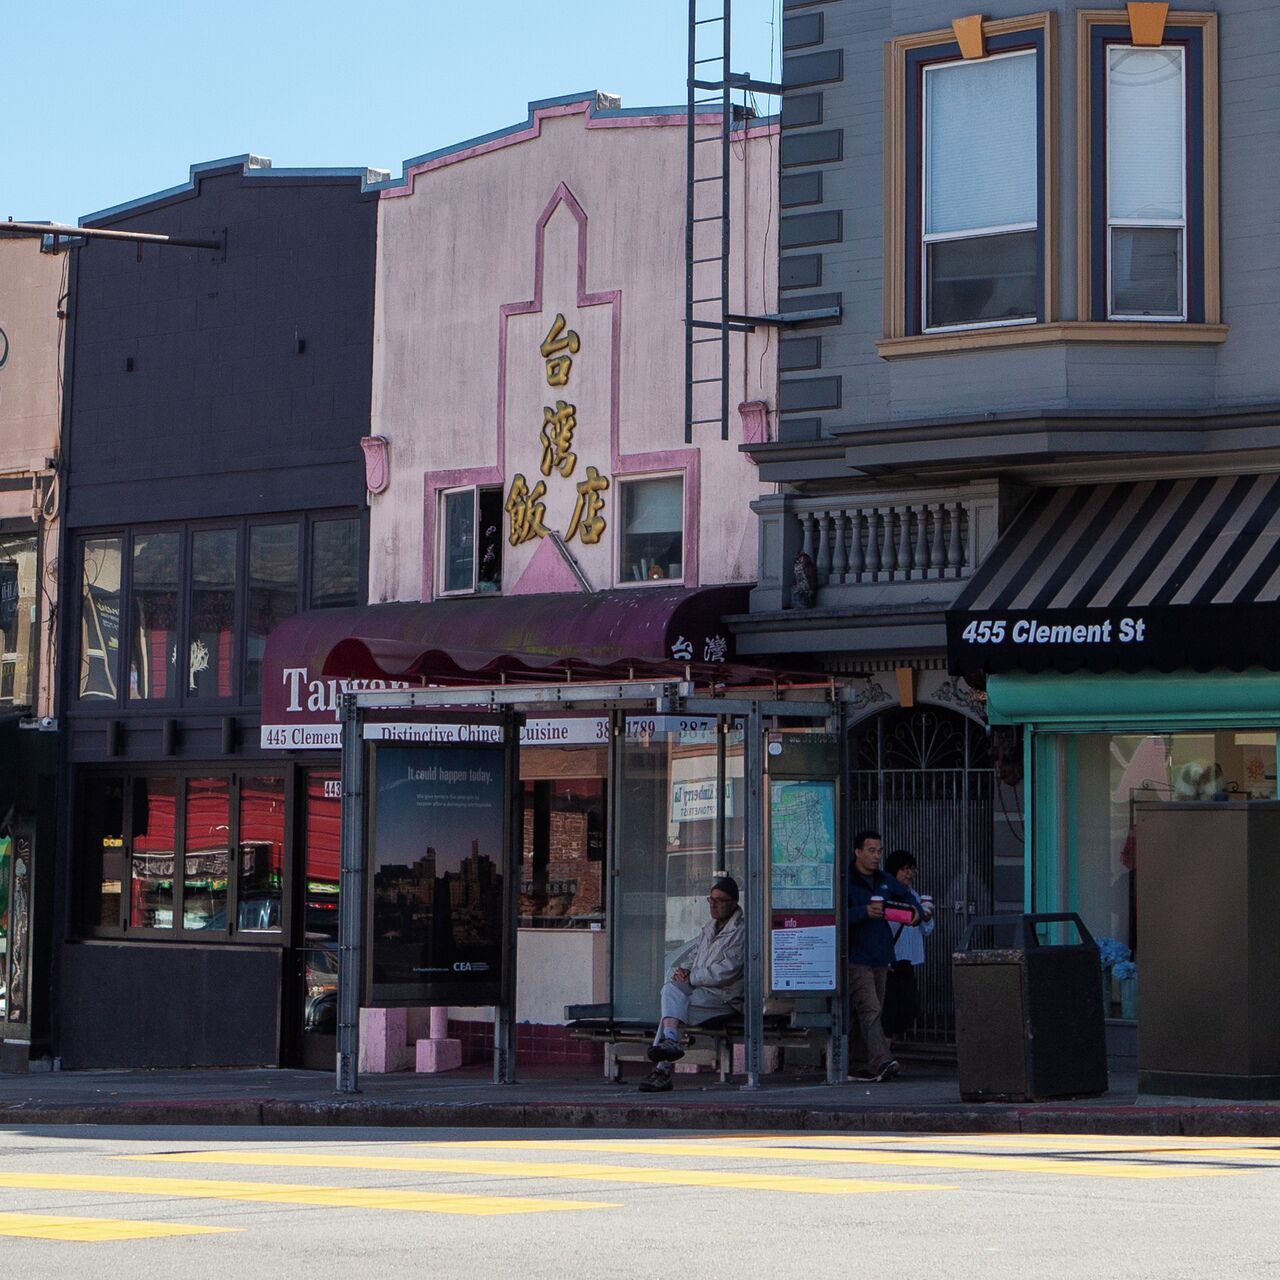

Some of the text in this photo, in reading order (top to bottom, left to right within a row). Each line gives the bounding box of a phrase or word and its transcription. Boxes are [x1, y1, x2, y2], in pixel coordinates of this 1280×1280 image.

[962, 617, 1145, 644] 455 Clement St
[267, 729, 287, 745] 445
[381, 726, 454, 741] Distinctive
[458, 725, 501, 742] Chine
[408, 766, 493, 785] It could happen today.
[324, 780, 341, 797] 443
[784, 917, 798, 928] info
[453, 962, 472, 972] CEA
